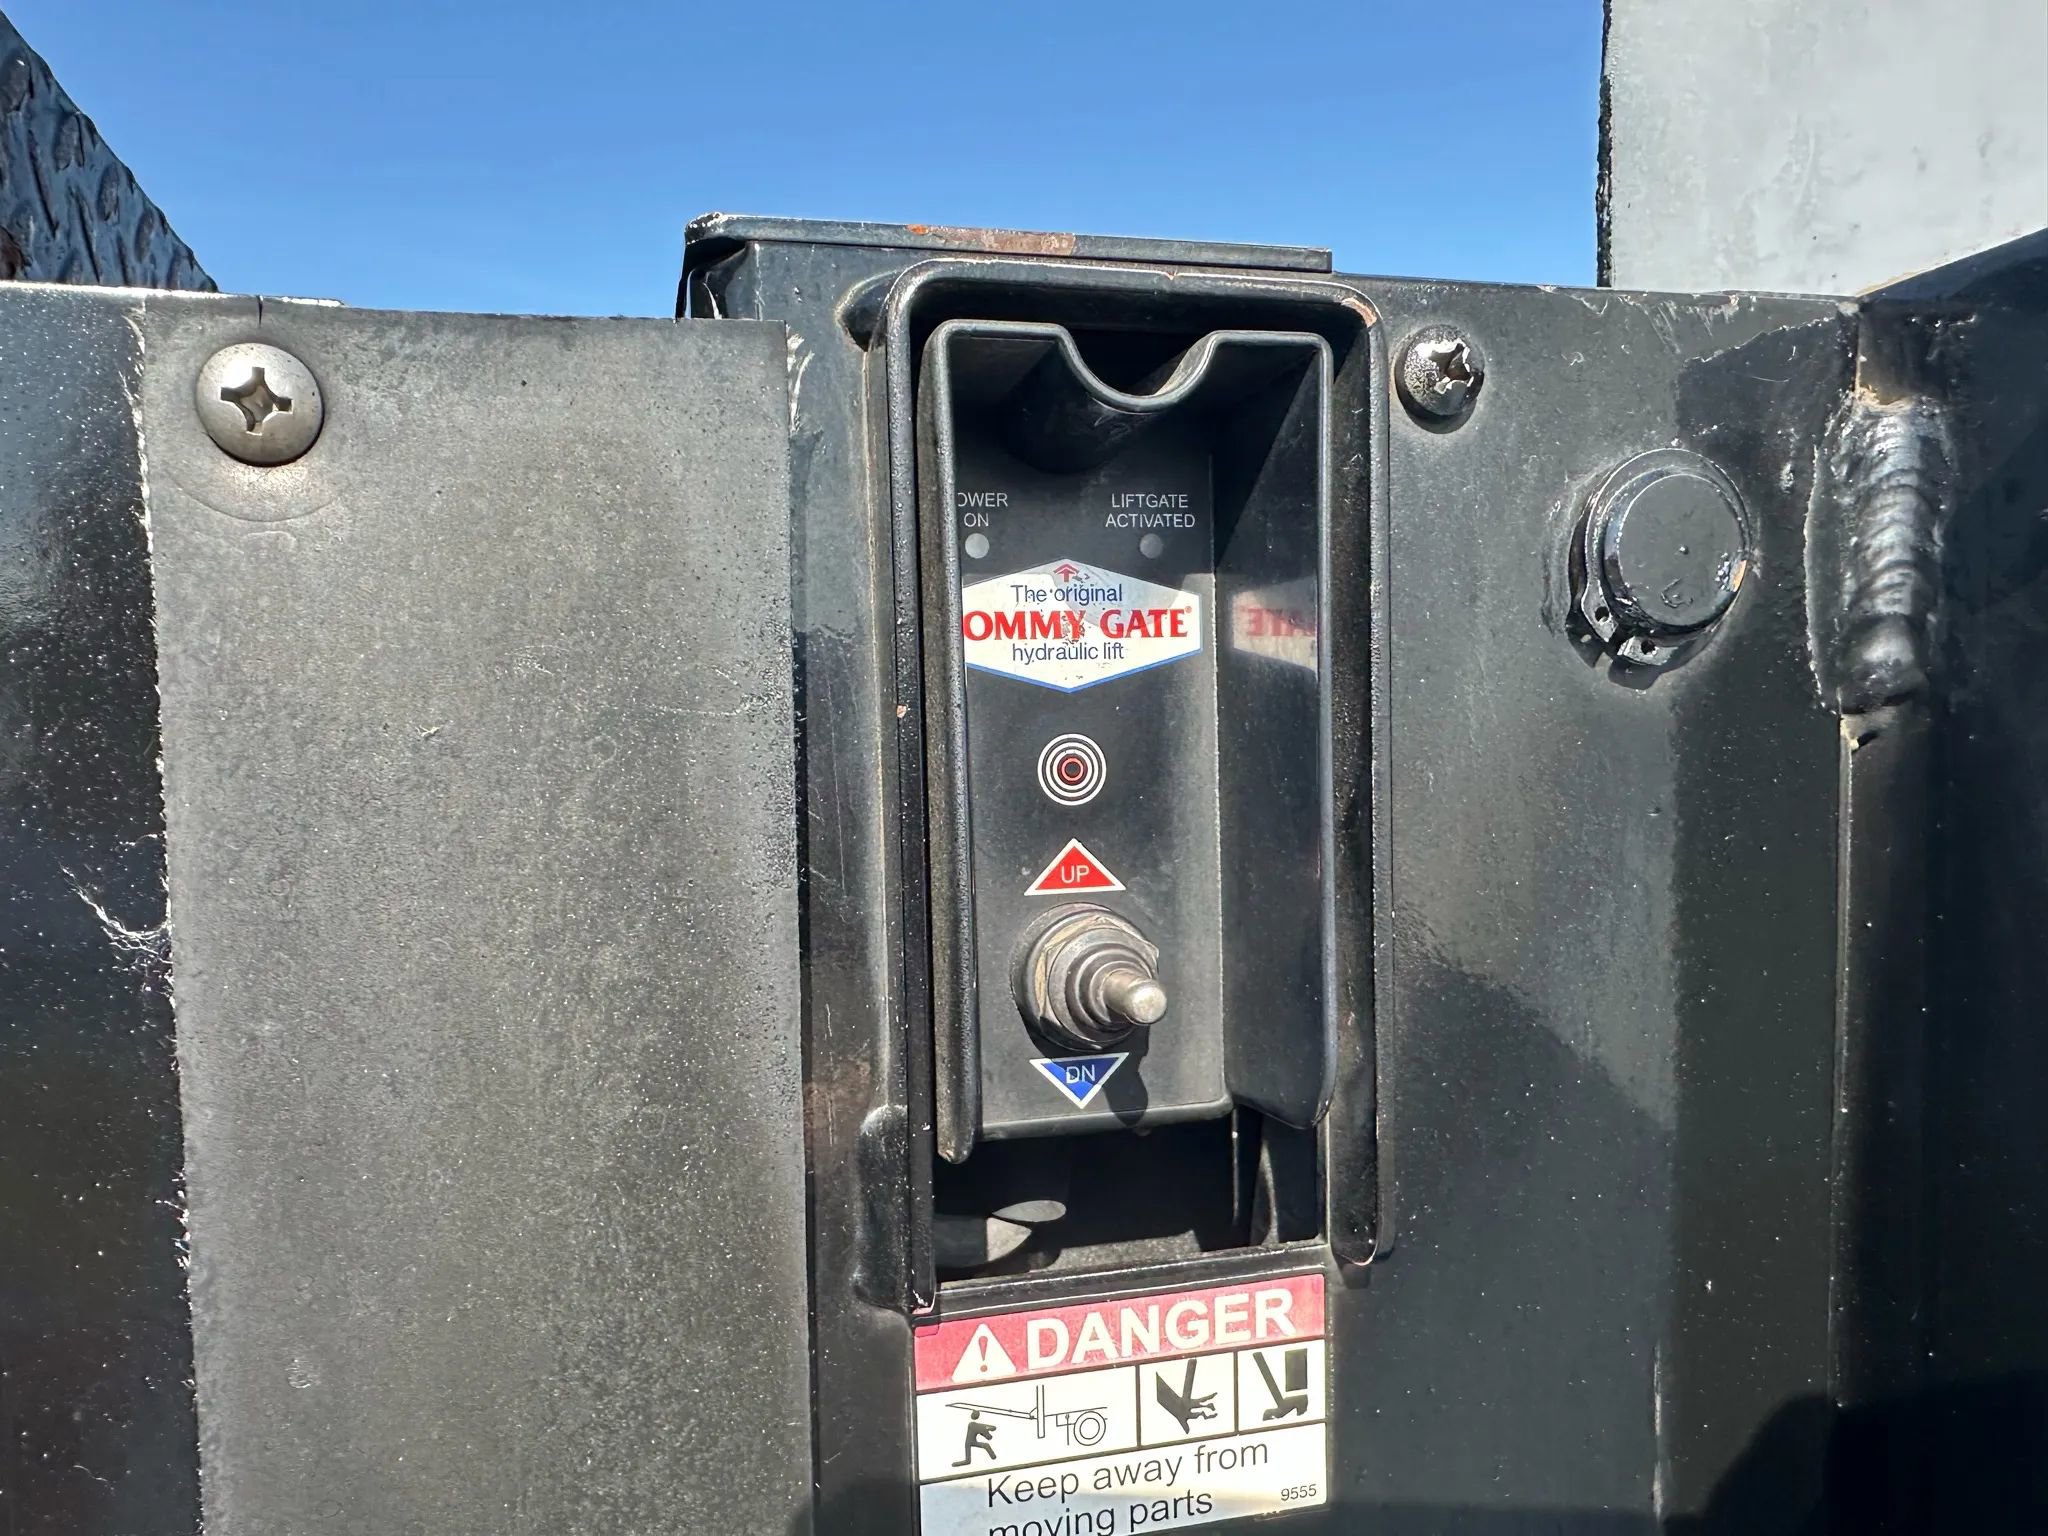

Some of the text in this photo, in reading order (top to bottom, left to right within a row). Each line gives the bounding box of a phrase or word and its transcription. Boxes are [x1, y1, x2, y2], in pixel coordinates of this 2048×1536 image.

[958, 493, 1008, 507] OWER
[1111, 494, 1188, 508] LIFTGATE
[963, 513, 989, 527] ON
[1105, 514, 1195, 528] ACTIVATED
[1011, 583, 1123, 604] The original
[963, 609, 1085, 640] OMMY
[1012, 642, 1124, 664] hydraulic lift
[1060, 865, 1090, 884] UP
[1065, 1065, 1095, 1083] DN
[1027, 1289, 1296, 1370] DANGER
[988, 1442, 1268, 1508] Keep away from
[1280, 1484, 1317, 1501] 9555
[1129, 1491, 1213, 1534] parts
